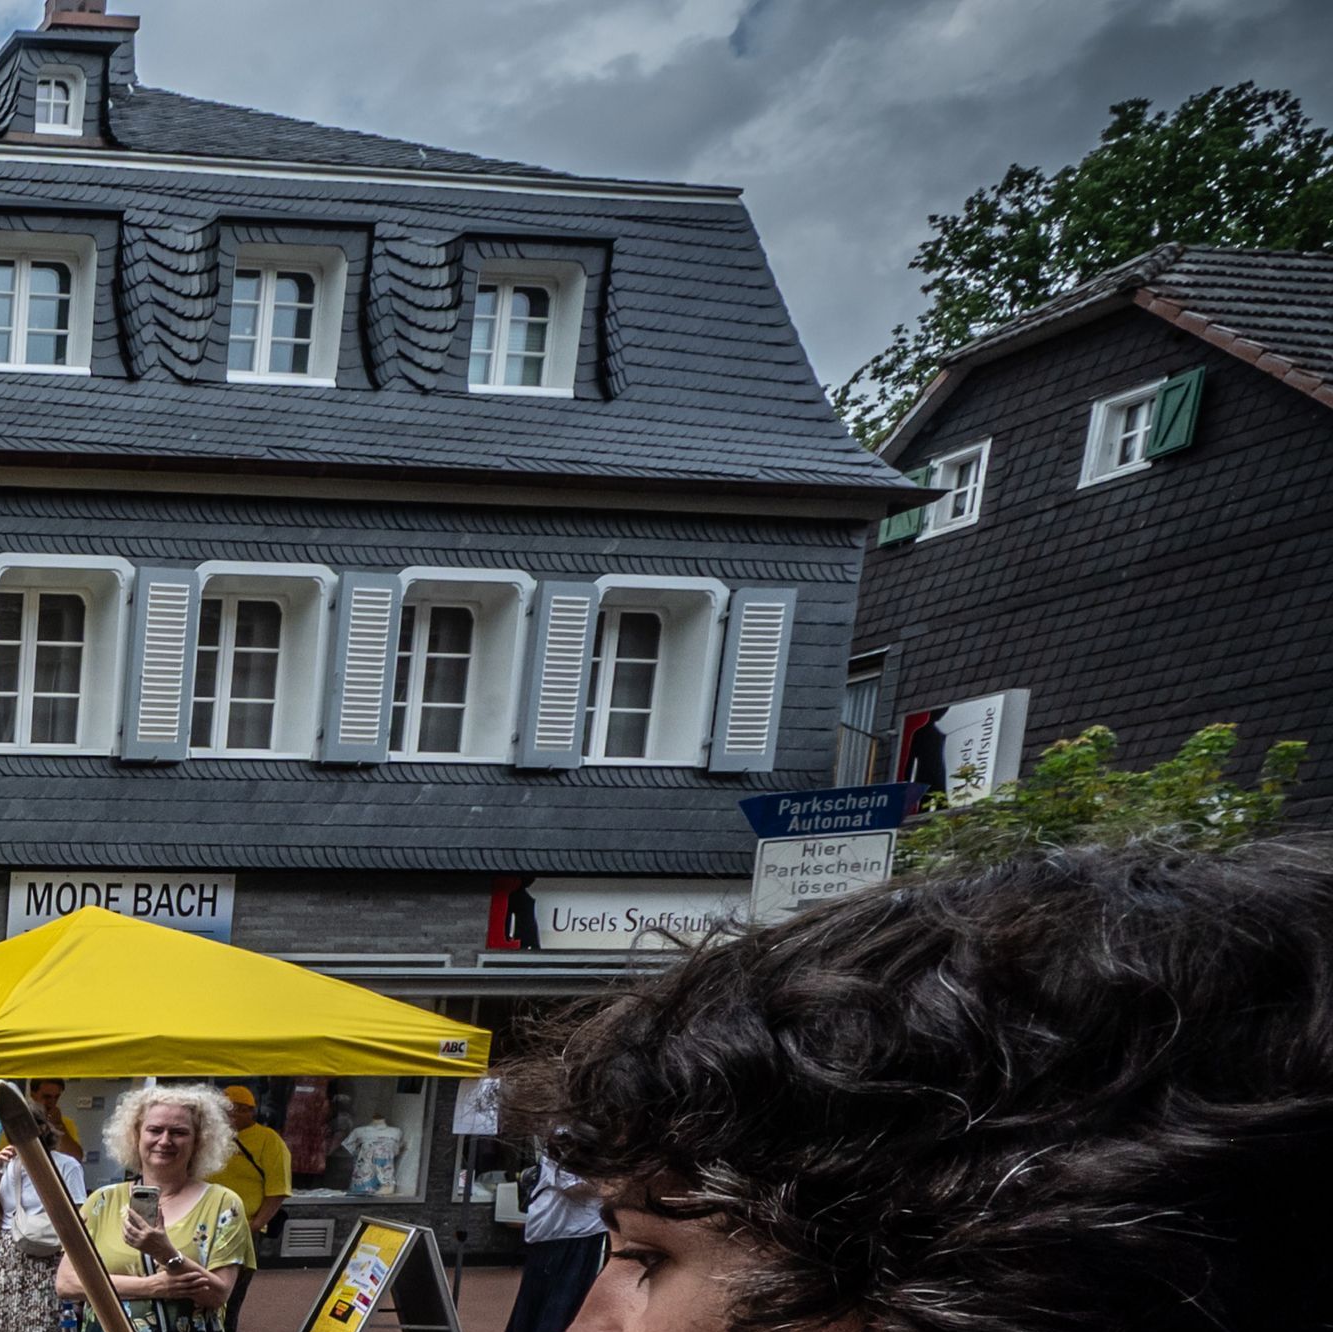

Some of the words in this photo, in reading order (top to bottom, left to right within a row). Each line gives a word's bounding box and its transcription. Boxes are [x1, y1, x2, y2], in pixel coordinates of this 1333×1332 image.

[778, 792, 889, 816] Parkschein
[787, 810, 873, 832] Automat
[802, 843, 848, 858] Hier
[764, 858, 882, 879] Parkschein
[791, 880, 848, 896] lösen
[26, 881, 123, 917] MODE
[133, 882, 219, 917] BACH
[442, 1041, 465, 1053] ABC
